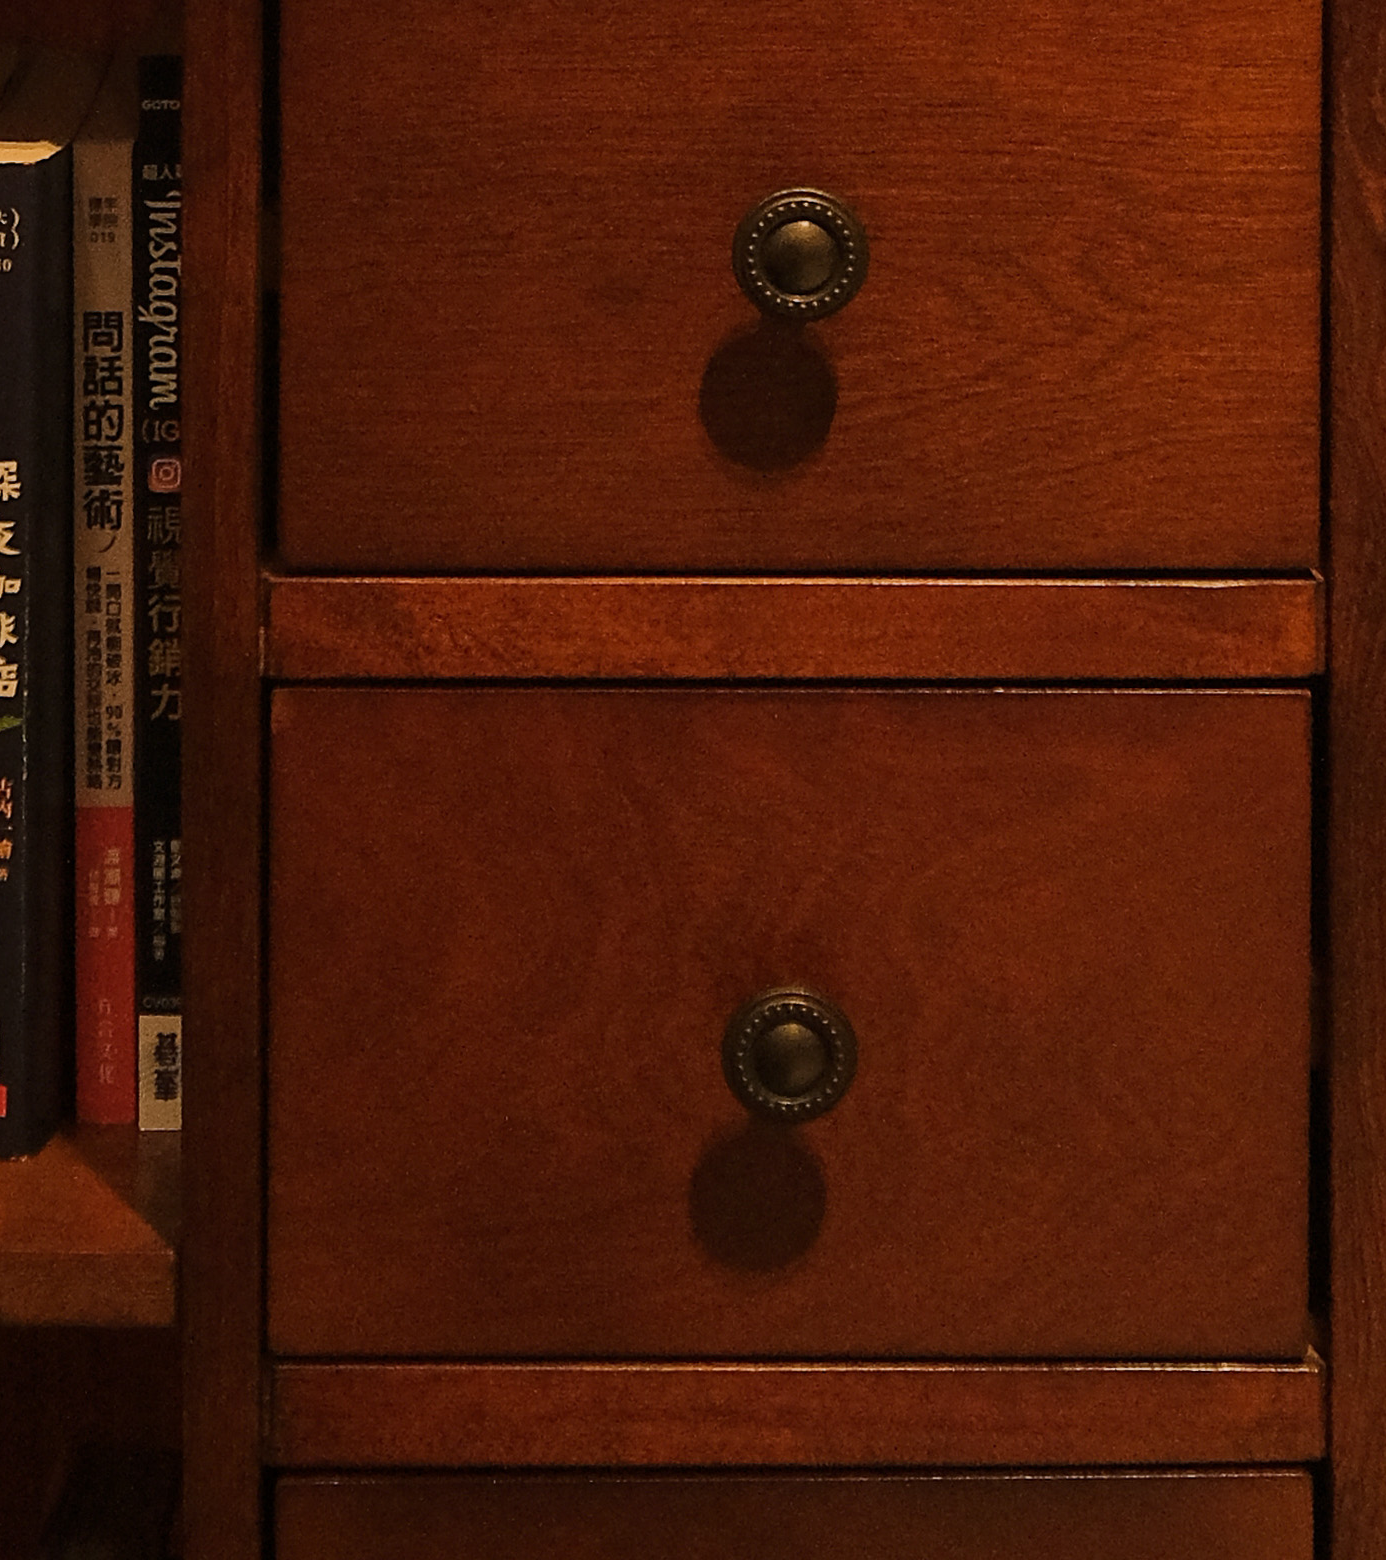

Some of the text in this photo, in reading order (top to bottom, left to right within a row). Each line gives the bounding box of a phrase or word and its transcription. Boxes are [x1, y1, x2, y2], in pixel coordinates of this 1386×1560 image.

[138, 187, 182, 411] Instagram
[81, 310, 126, 532] 問話的藝術
